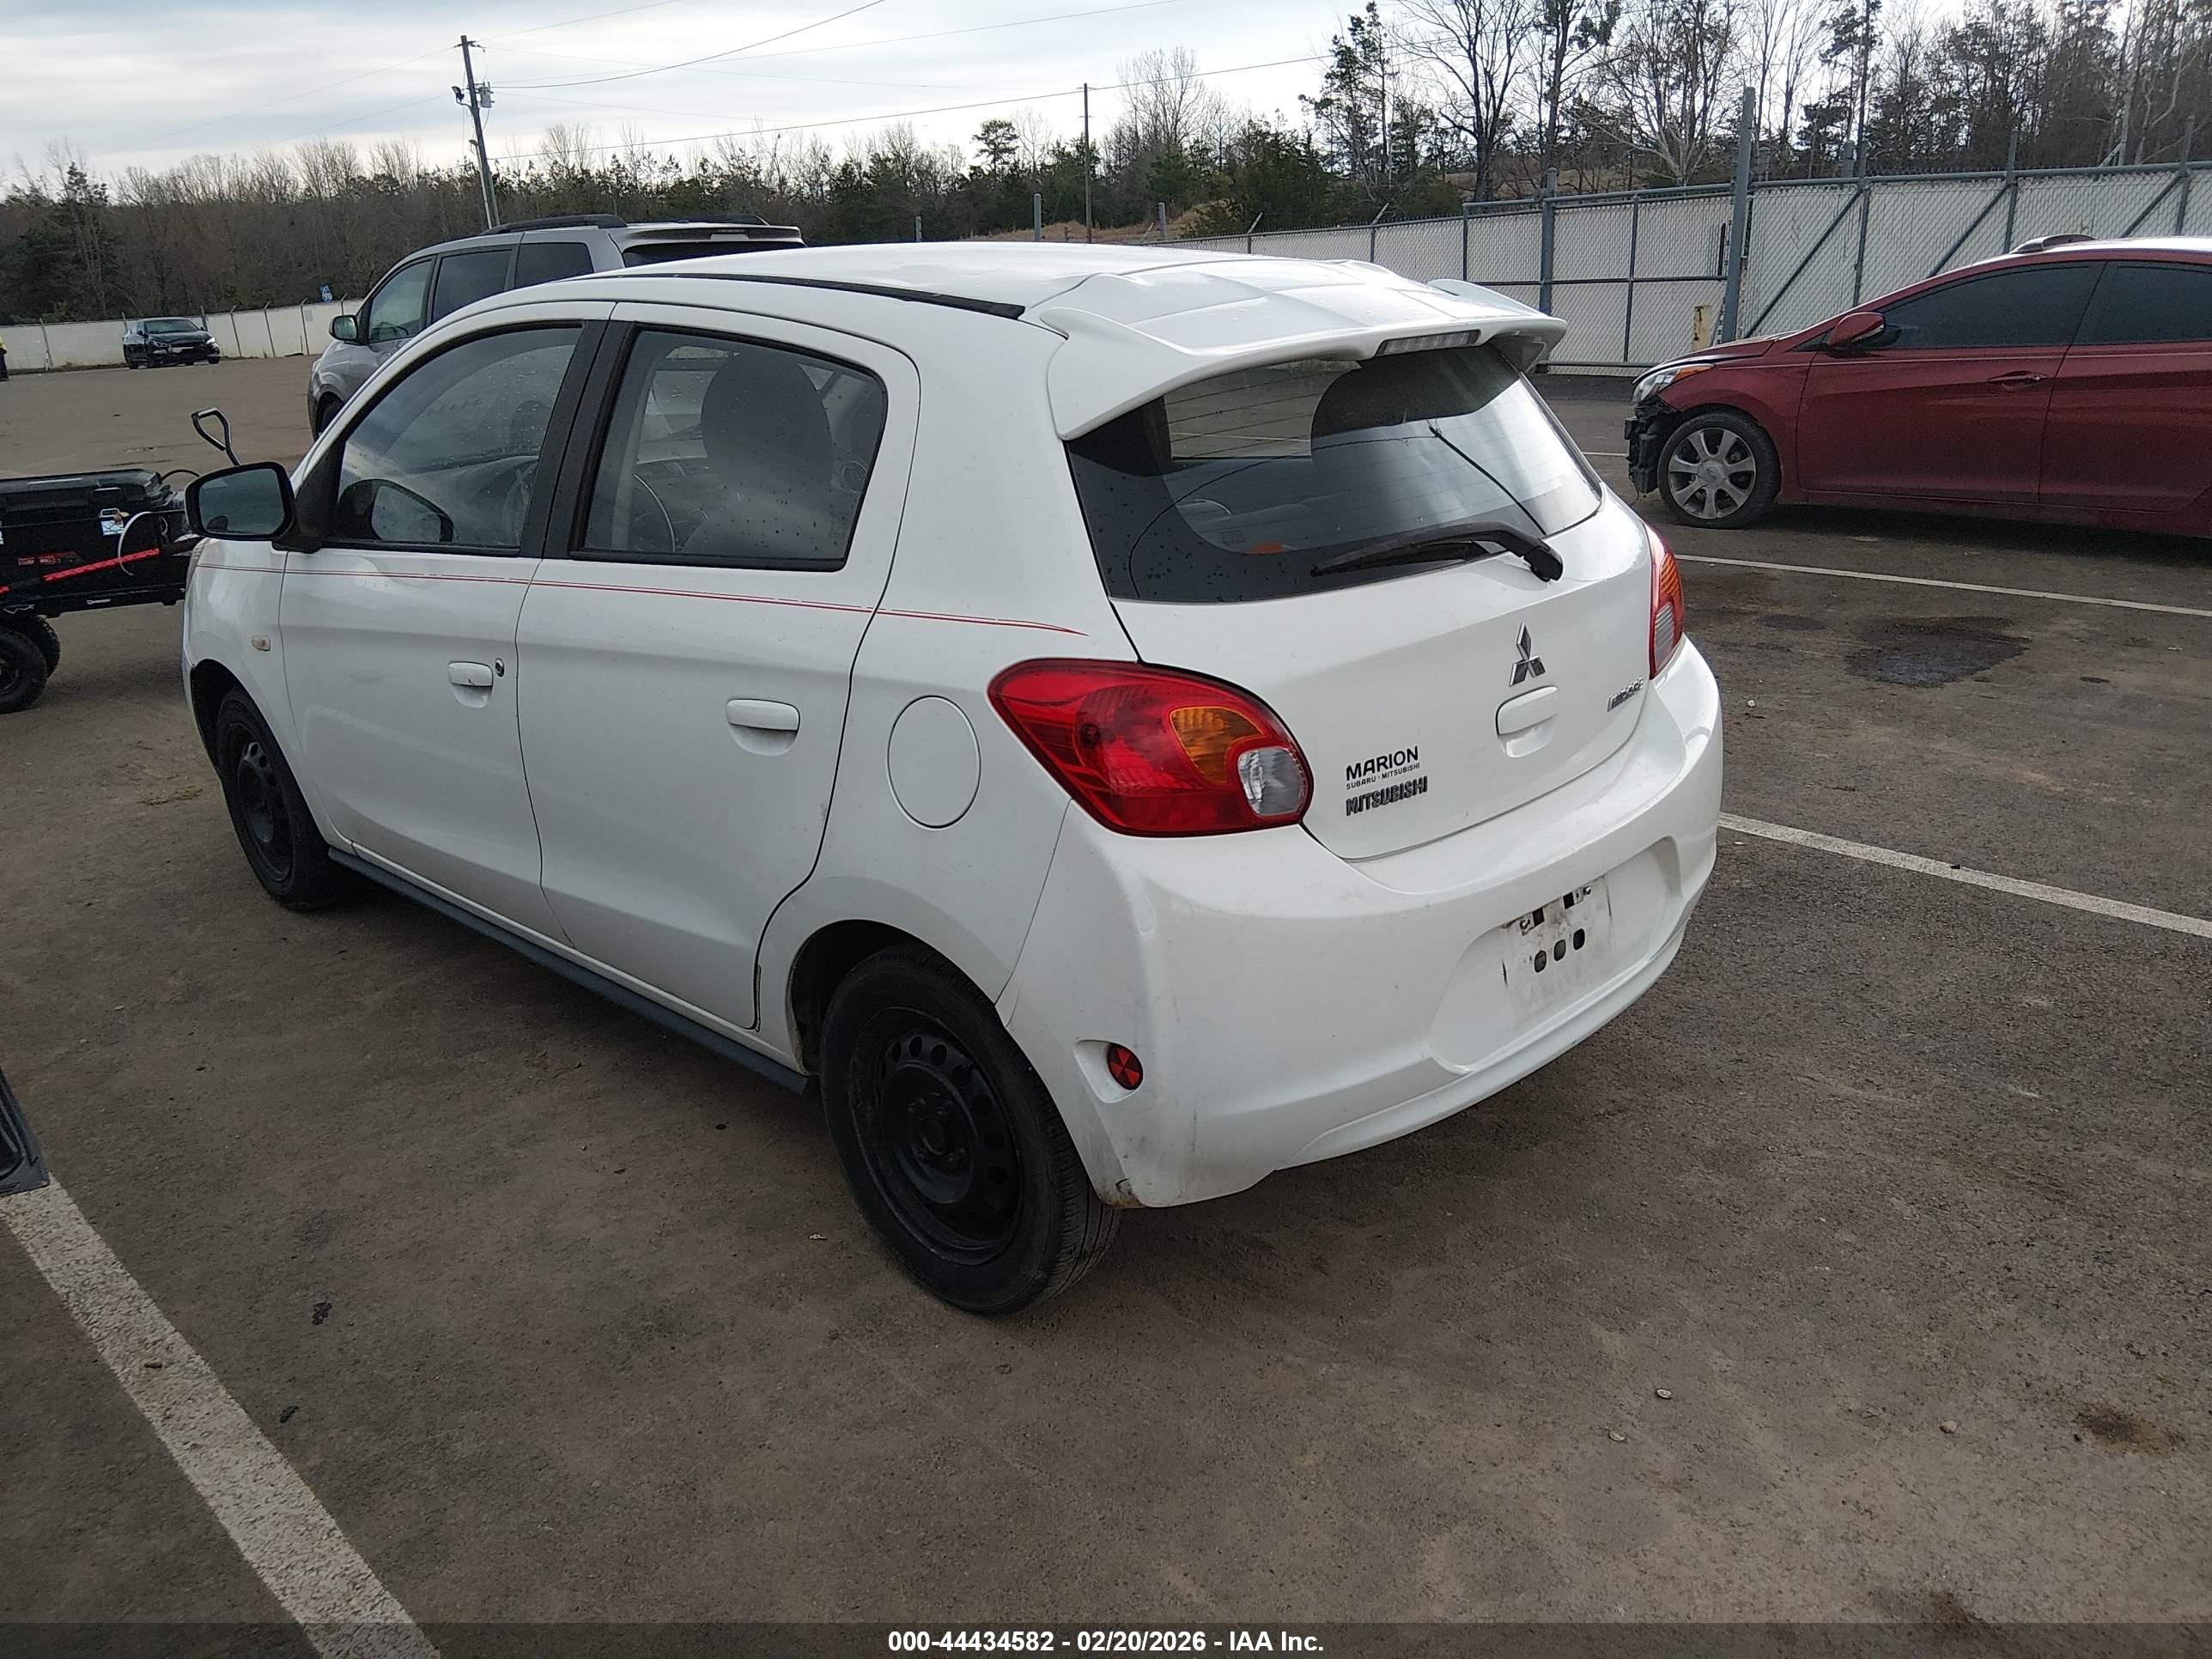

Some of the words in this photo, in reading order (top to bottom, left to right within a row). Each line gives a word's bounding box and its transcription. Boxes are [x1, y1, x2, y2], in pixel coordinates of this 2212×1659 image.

[1346, 745, 1419, 781] MARION
[1346, 776, 1376, 790] SUBARU
[1382, 763, 1420, 780] MITSUBISHI
[1346, 775, 1428, 817] MITSUBISHI
